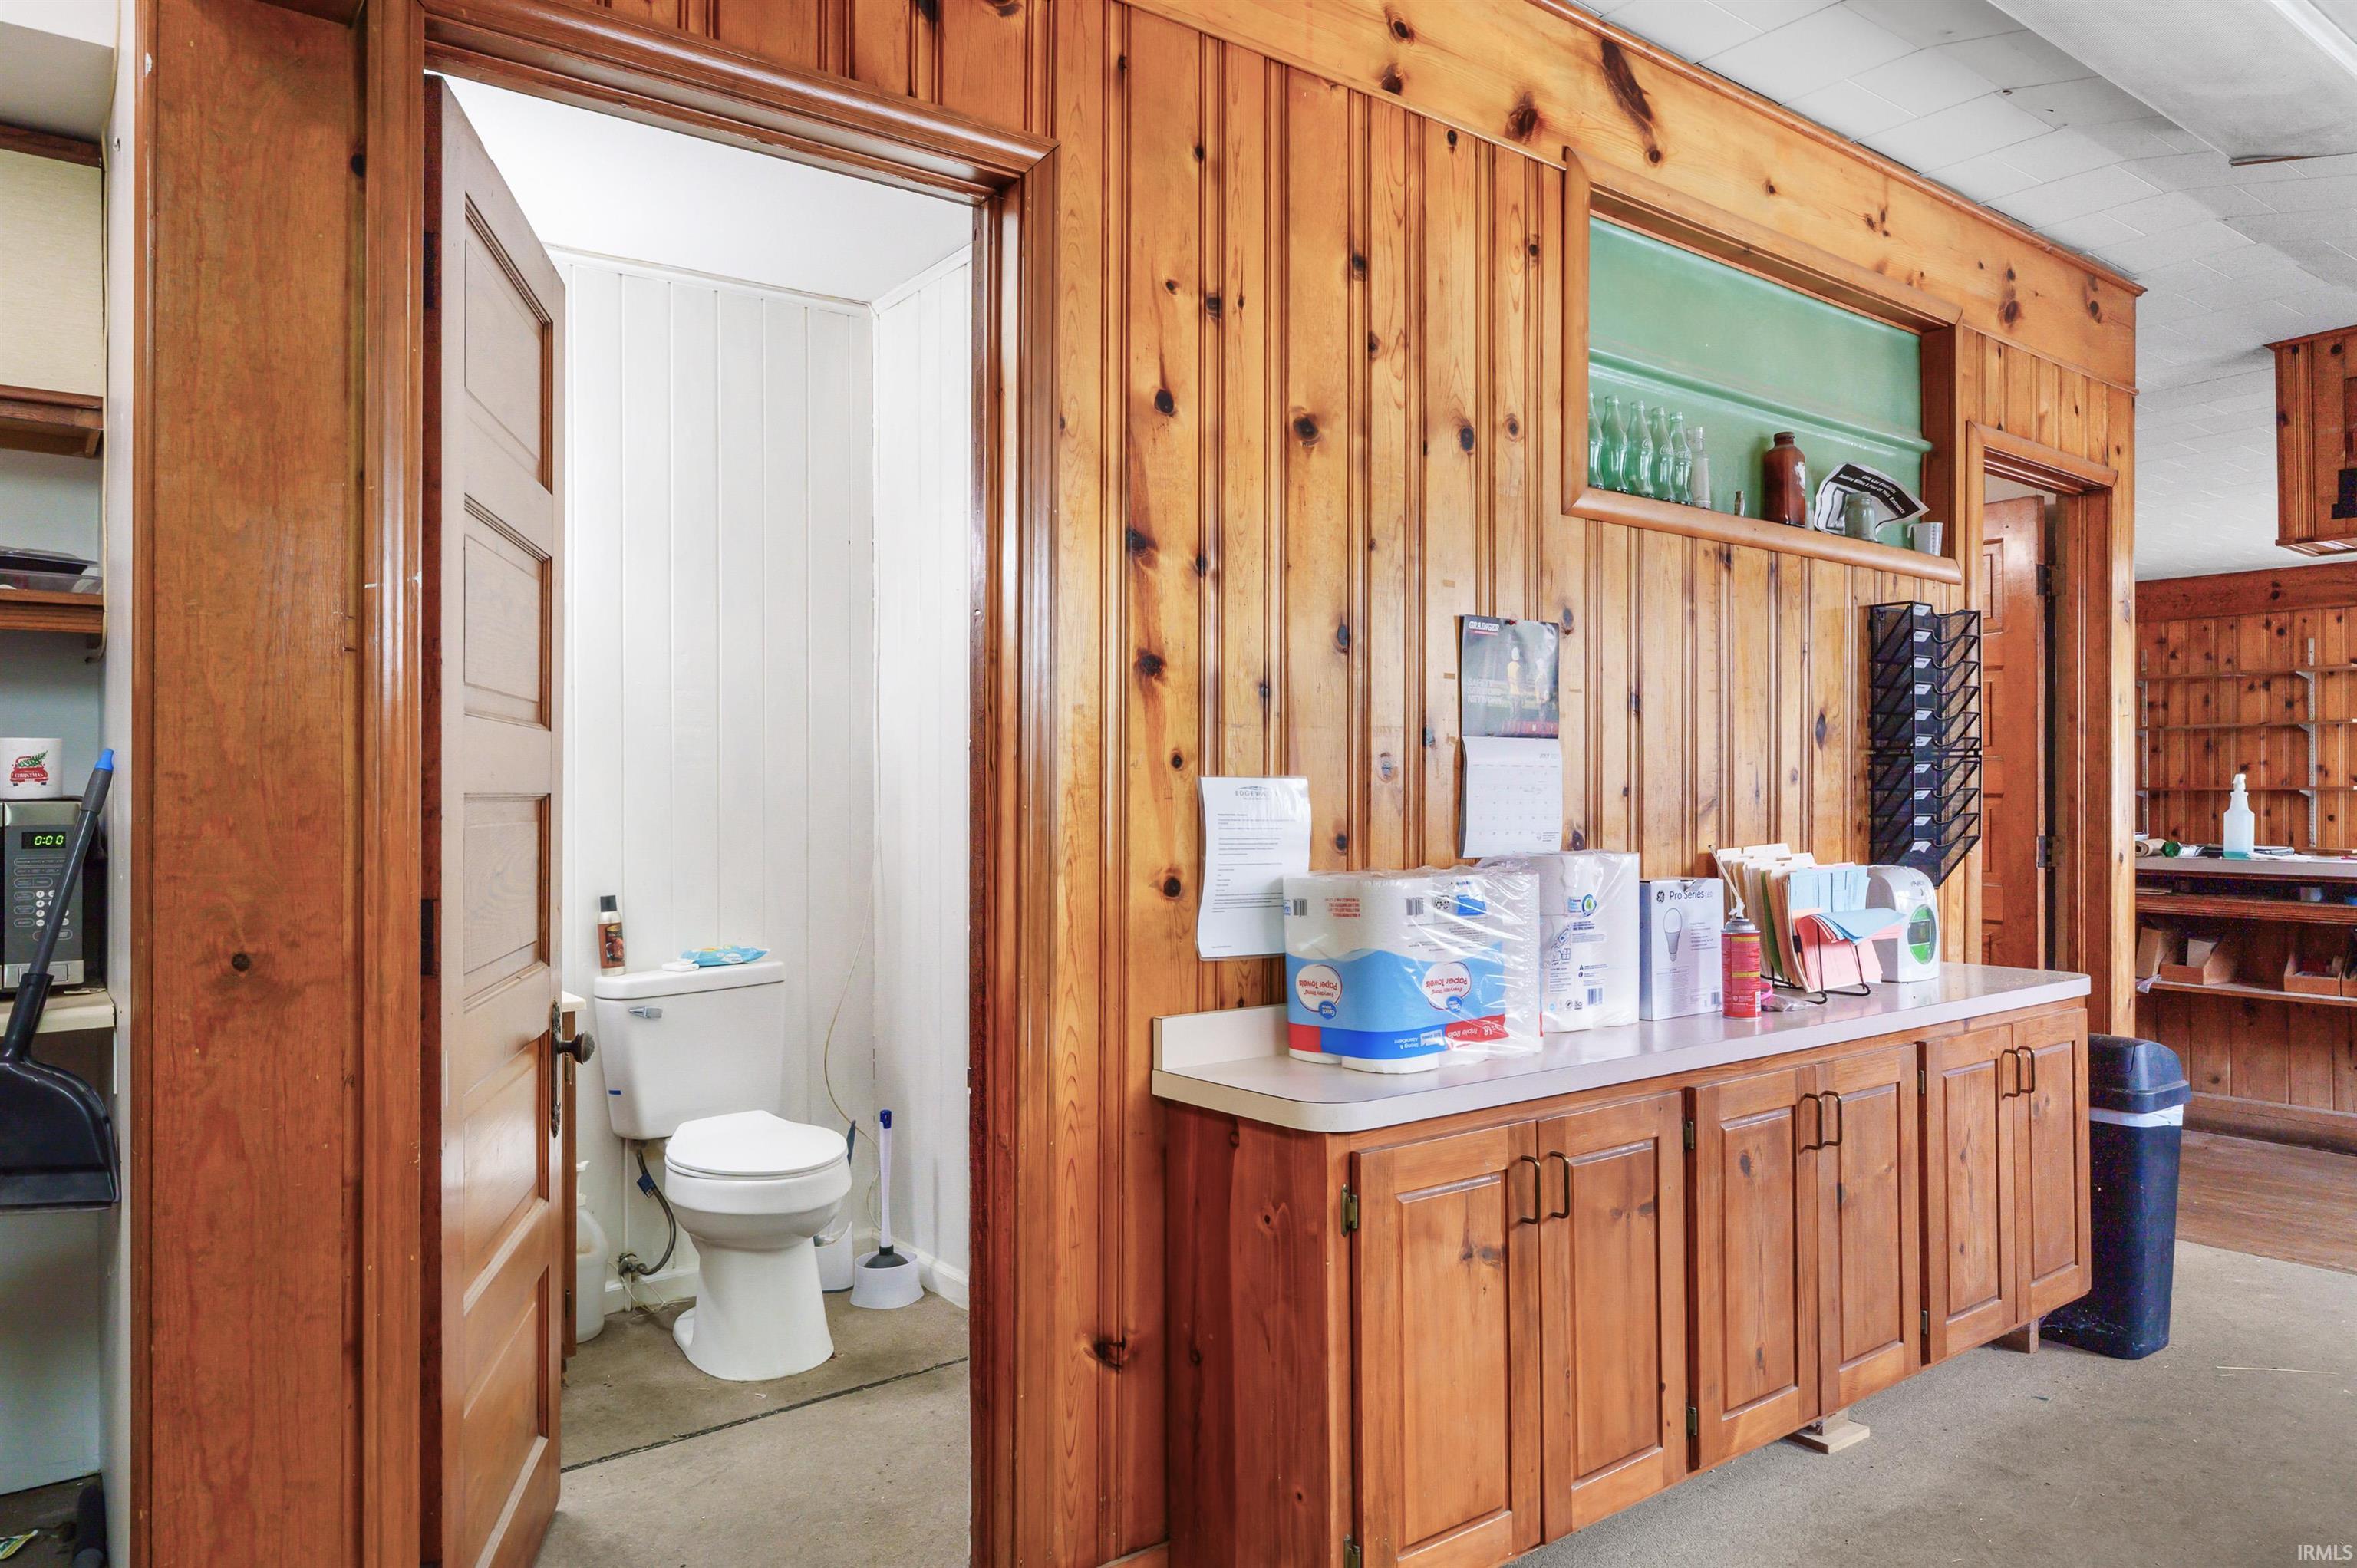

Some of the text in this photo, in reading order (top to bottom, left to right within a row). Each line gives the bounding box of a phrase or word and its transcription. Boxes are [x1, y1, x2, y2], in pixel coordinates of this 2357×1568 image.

[1889, 496, 1905, 514] Entrance
[1469, 621, 1499, 632] GRAINGER
[35, 835, 64, 845] 0:00
[1670, 891, 1683, 900] Pro
[1684, 890, 1704, 900] Series
[1299, 979, 1337, 991] Paper Towels
[1426, 977, 1468, 989] Paper Towels
[1448, 1029, 1462, 1039] Rolls
